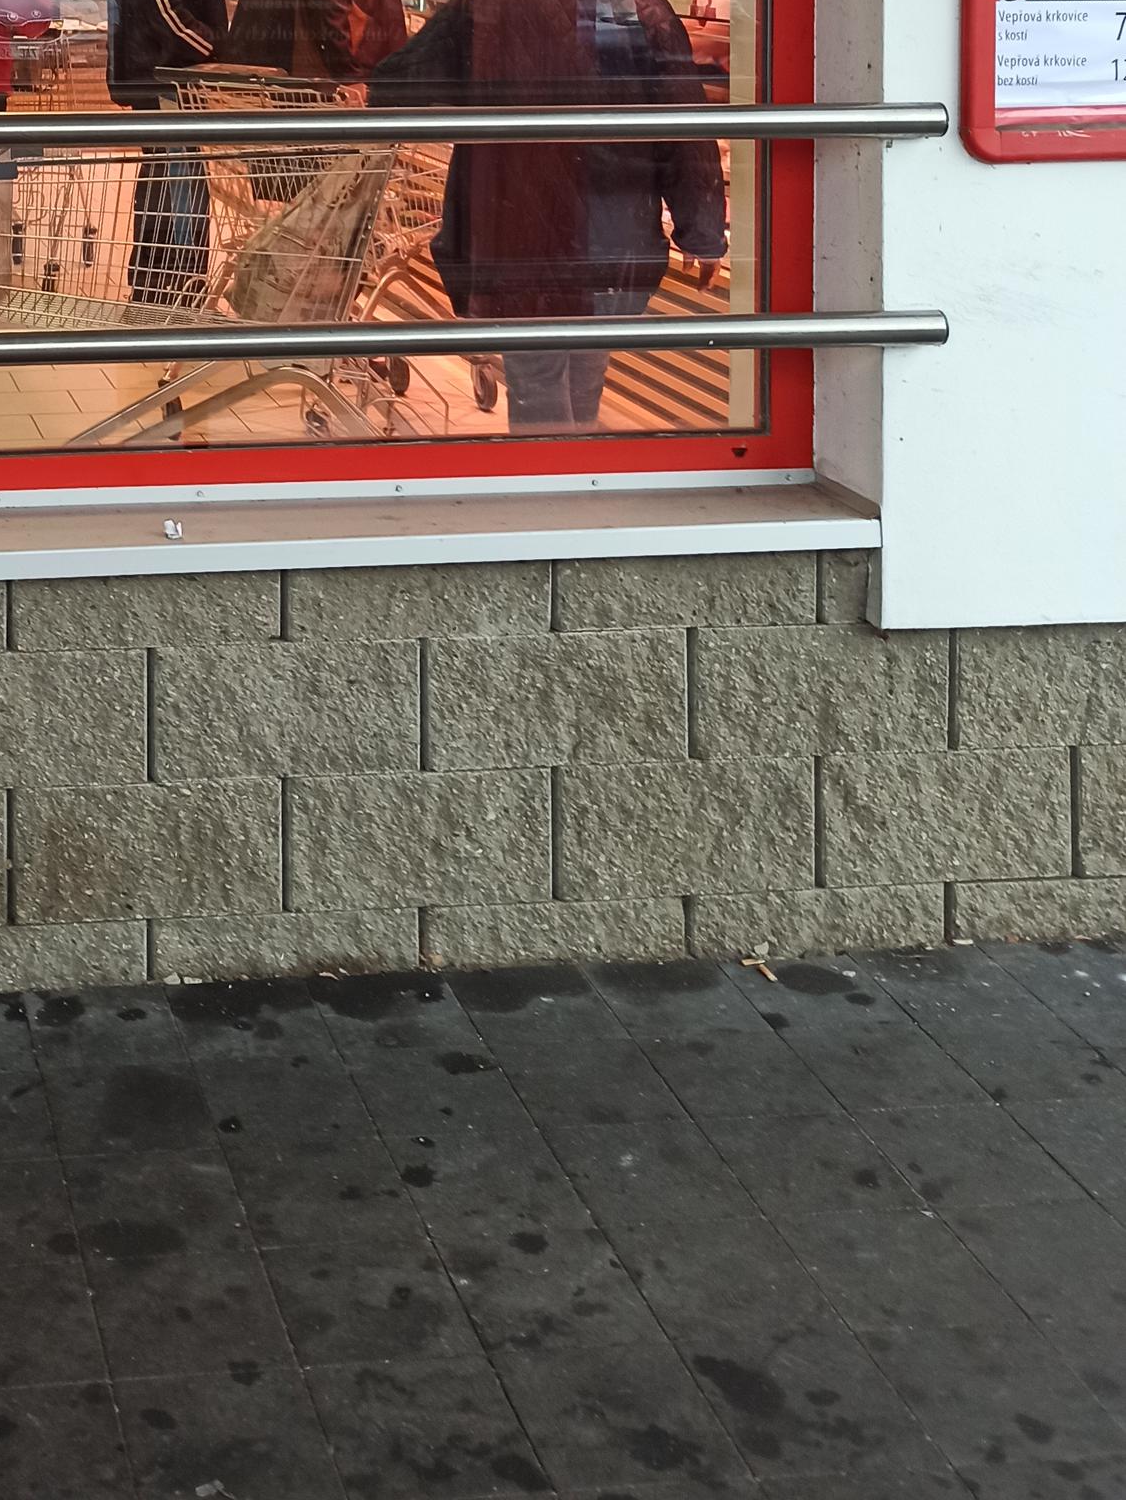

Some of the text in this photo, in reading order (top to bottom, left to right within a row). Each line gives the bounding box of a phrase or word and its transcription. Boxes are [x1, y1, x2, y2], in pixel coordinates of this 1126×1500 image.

[997, 9, 1089, 25] Vepřová krkovice
[1004, 29, 1028, 41] kostí
[996, 54, 1088, 70] Vepřová krkovice
[997, 75, 1014, 86] bez
